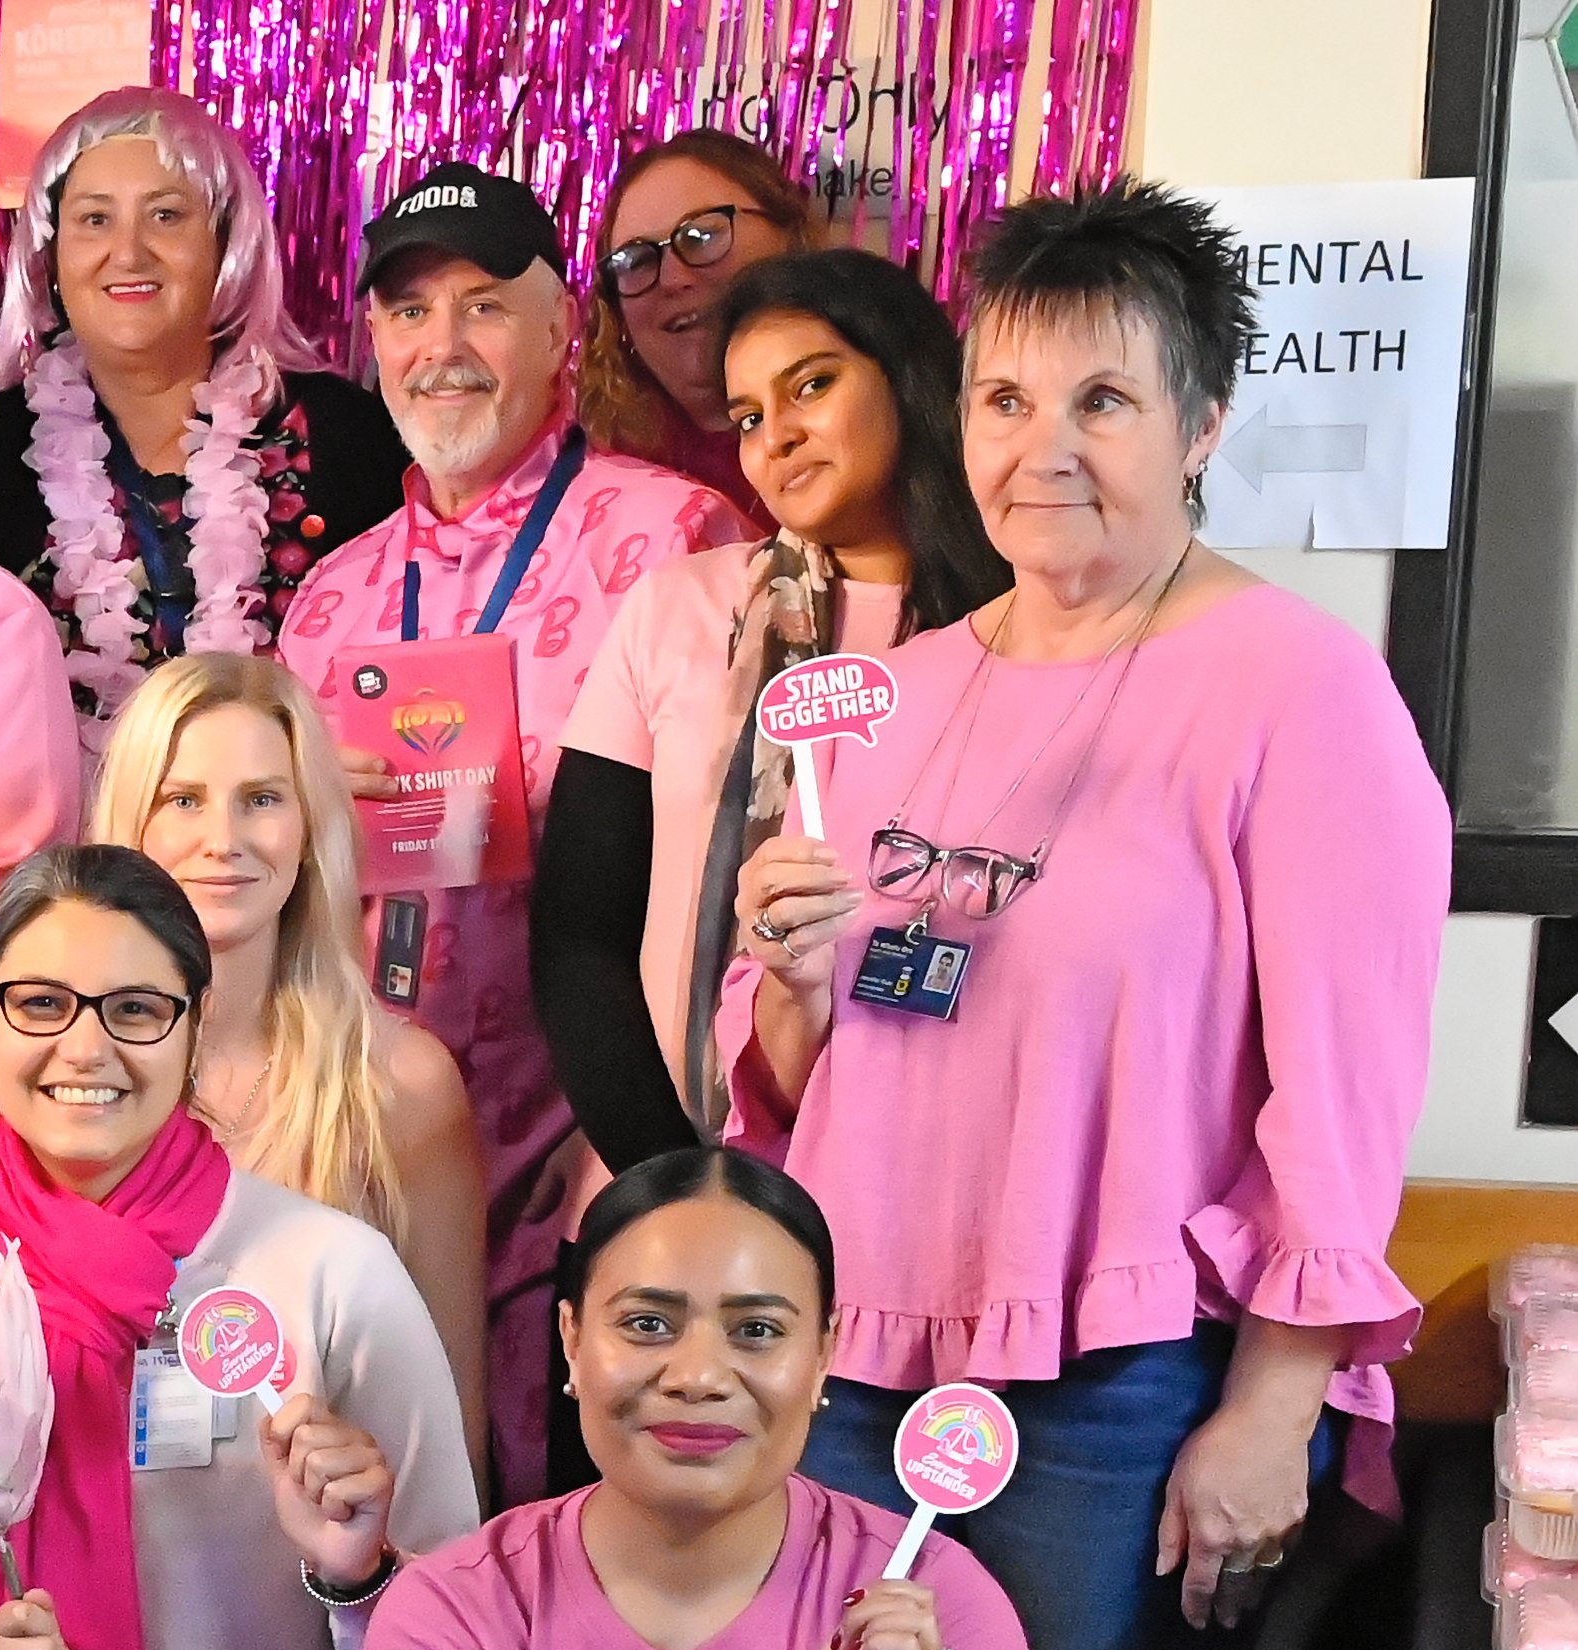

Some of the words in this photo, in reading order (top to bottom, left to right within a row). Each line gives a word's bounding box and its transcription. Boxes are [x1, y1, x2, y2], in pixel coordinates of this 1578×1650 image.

[395, 186, 458, 218] FOOD
[1244, 329, 1407, 375] EALTH
[784, 664, 864, 702] STAND
[763, 686, 890, 731] TOGETHER
[414, 769, 463, 792] SHIRT
[465, 765, 497, 786] DAY
[392, 839, 427, 854] FRIDAY
[218, 1341, 275, 1390] UPSTANDER
[906, 1459, 977, 1500] UPSTANDER
